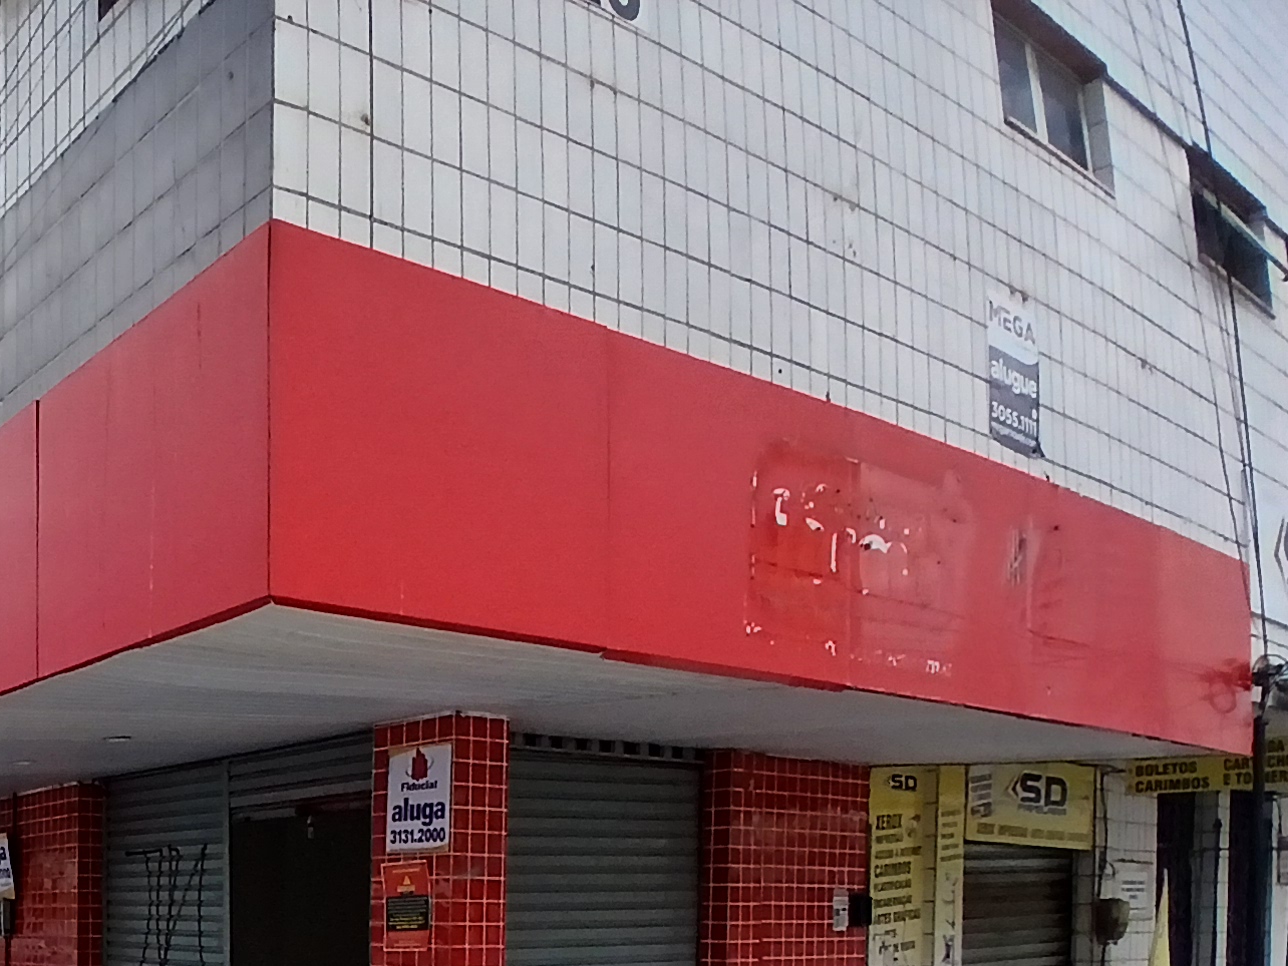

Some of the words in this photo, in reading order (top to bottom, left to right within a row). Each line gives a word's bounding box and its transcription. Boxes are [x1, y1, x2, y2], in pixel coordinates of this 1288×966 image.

[988, 299, 1036, 345] MEGA
[990, 358, 1037, 399] alugue
[1135, 761, 1198, 777] BOLETOS
[400, 779, 438, 793] Fiducial
[890, 774, 918, 792] SD
[1019, 772, 1068, 808] SD
[1135, 777, 1210, 793] CARIMBOS
[391, 798, 446, 827] aluga
[390, 827, 446, 844] 3131.2000
